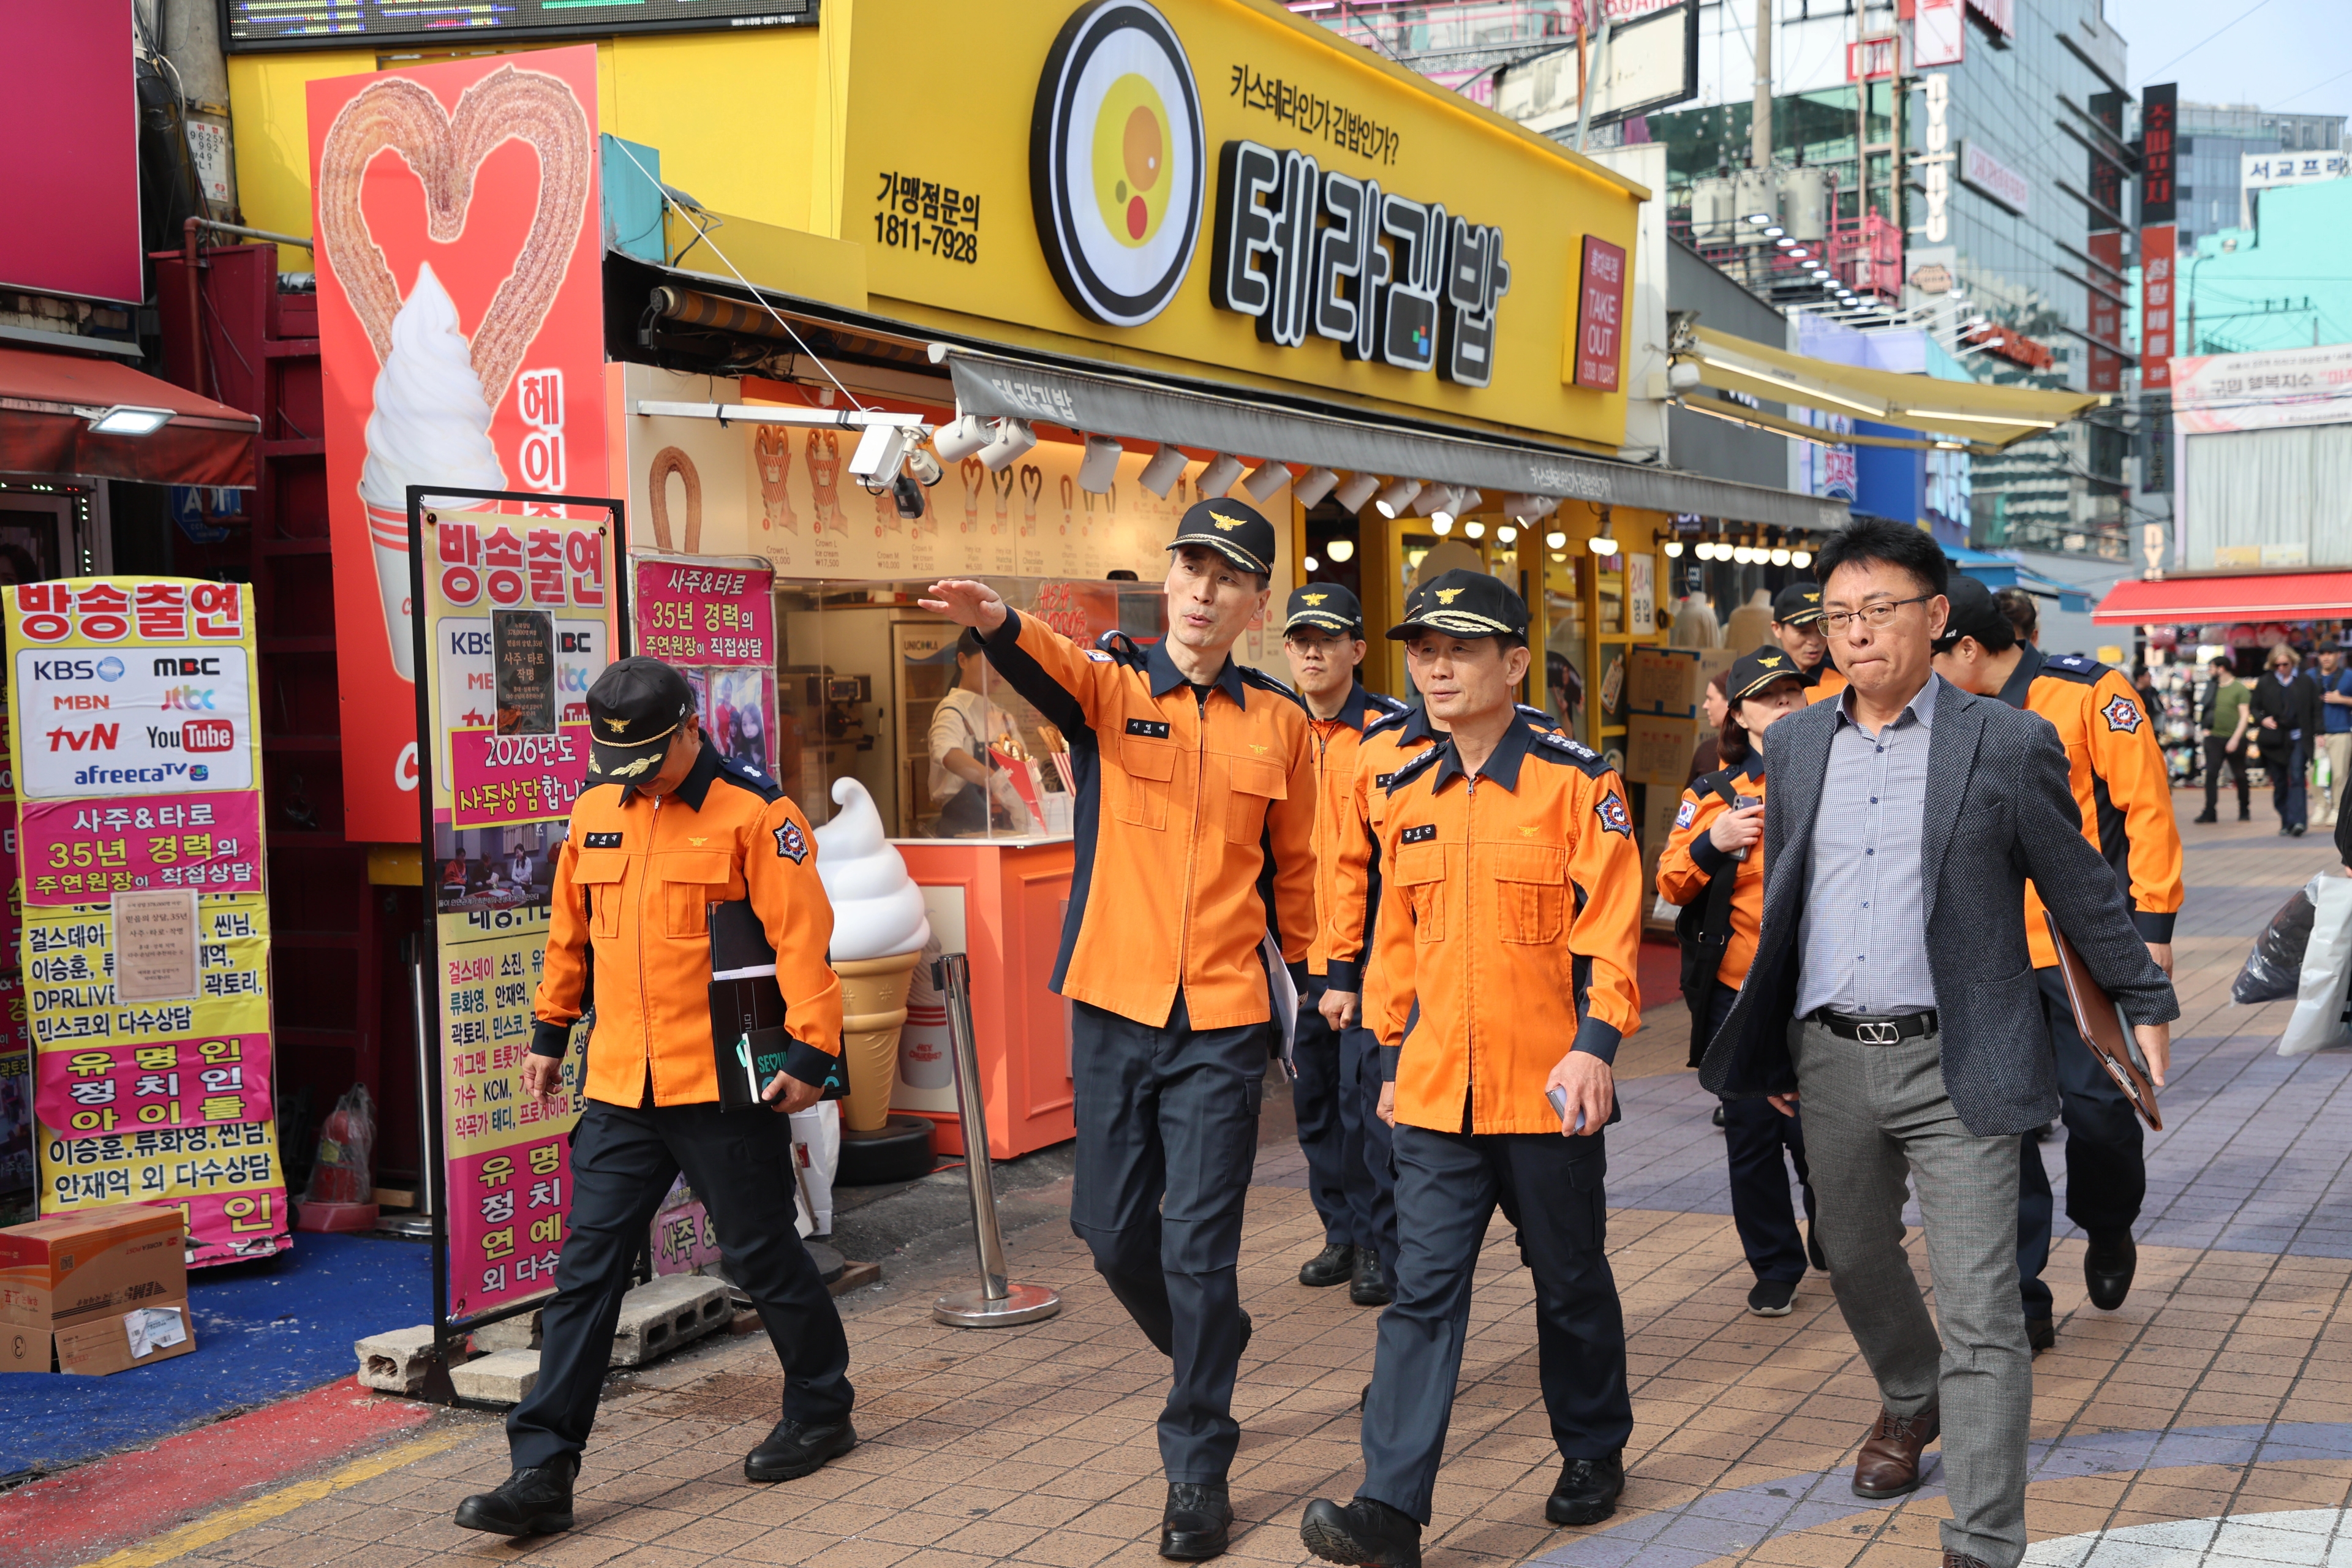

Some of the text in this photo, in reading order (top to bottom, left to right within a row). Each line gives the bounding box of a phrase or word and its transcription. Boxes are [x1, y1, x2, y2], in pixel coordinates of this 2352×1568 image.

[1231, 64, 1400, 166] 카스테라인가 김밥인가?
[876, 171, 980, 232] 가맹점문의
[875, 211, 978, 265] 1811-7928
[1223, 140, 1510, 388] 테라김밥
[1588, 288, 1617, 325] TAKE
[1588, 323, 1613, 358] OUT
[991, 378, 1078, 423] 테라김밥
[184, 486, 225, 513] AT
[766, 546, 785, 555] Crown
[815, 539, 832, 548] Crown
[438, 523, 605, 607] 방송출연
[667, 568, 746, 597] 사주&타로
[1039, 582, 1071, 610] HEY
[16, 582, 242, 641] 방송출연
[652, 600, 754, 633] 35년 경력의
[556, 632, 591, 654] BC
[646, 635, 763, 658] 주연원장이 직접상담
[34, 658, 221, 680] KBS MBC
[517, 668, 535, 681] 작명
[53, 695, 110, 710] MBN
[46, 723, 120, 752] tvN
[484, 735, 576, 767] 2026년도
[74, 763, 188, 785] afreecaTV
[460, 774, 586, 816] 사주상담합니
[72, 803, 216, 834] 사주&타로
[48, 837, 128, 869] 35년
[147, 832, 239, 864] 경력의
[34, 862, 254, 897] 주연원장이 직접상담
[29, 923, 105, 954] 걸스데이
[31, 954, 95, 983] 이승훈,
[205, 970, 263, 997] 곽토리,
[448, 952, 525, 986] 걸스데이 소진,
[450, 982, 530, 1016] 류화영, 안재억,
[36, 1012, 111, 1042] 민스코외
[118, 1005, 192, 1035] 다수상담
[451, 1014, 527, 1047] 곽토리, 민스코,
[453, 1050, 487, 1079] 개그맨
[454, 1077, 513, 1109] 가수 KCM,
[455, 1094, 569, 1140] 작곡가 태디, 프로게이머
[55, 1168, 130, 1204] 안재억
[141, 1164, 164, 1192] 외
[176, 1153, 271, 1190] 다수상담
[142, 1240, 164, 1251] KOREA
[481, 1264, 506, 1294] 외
